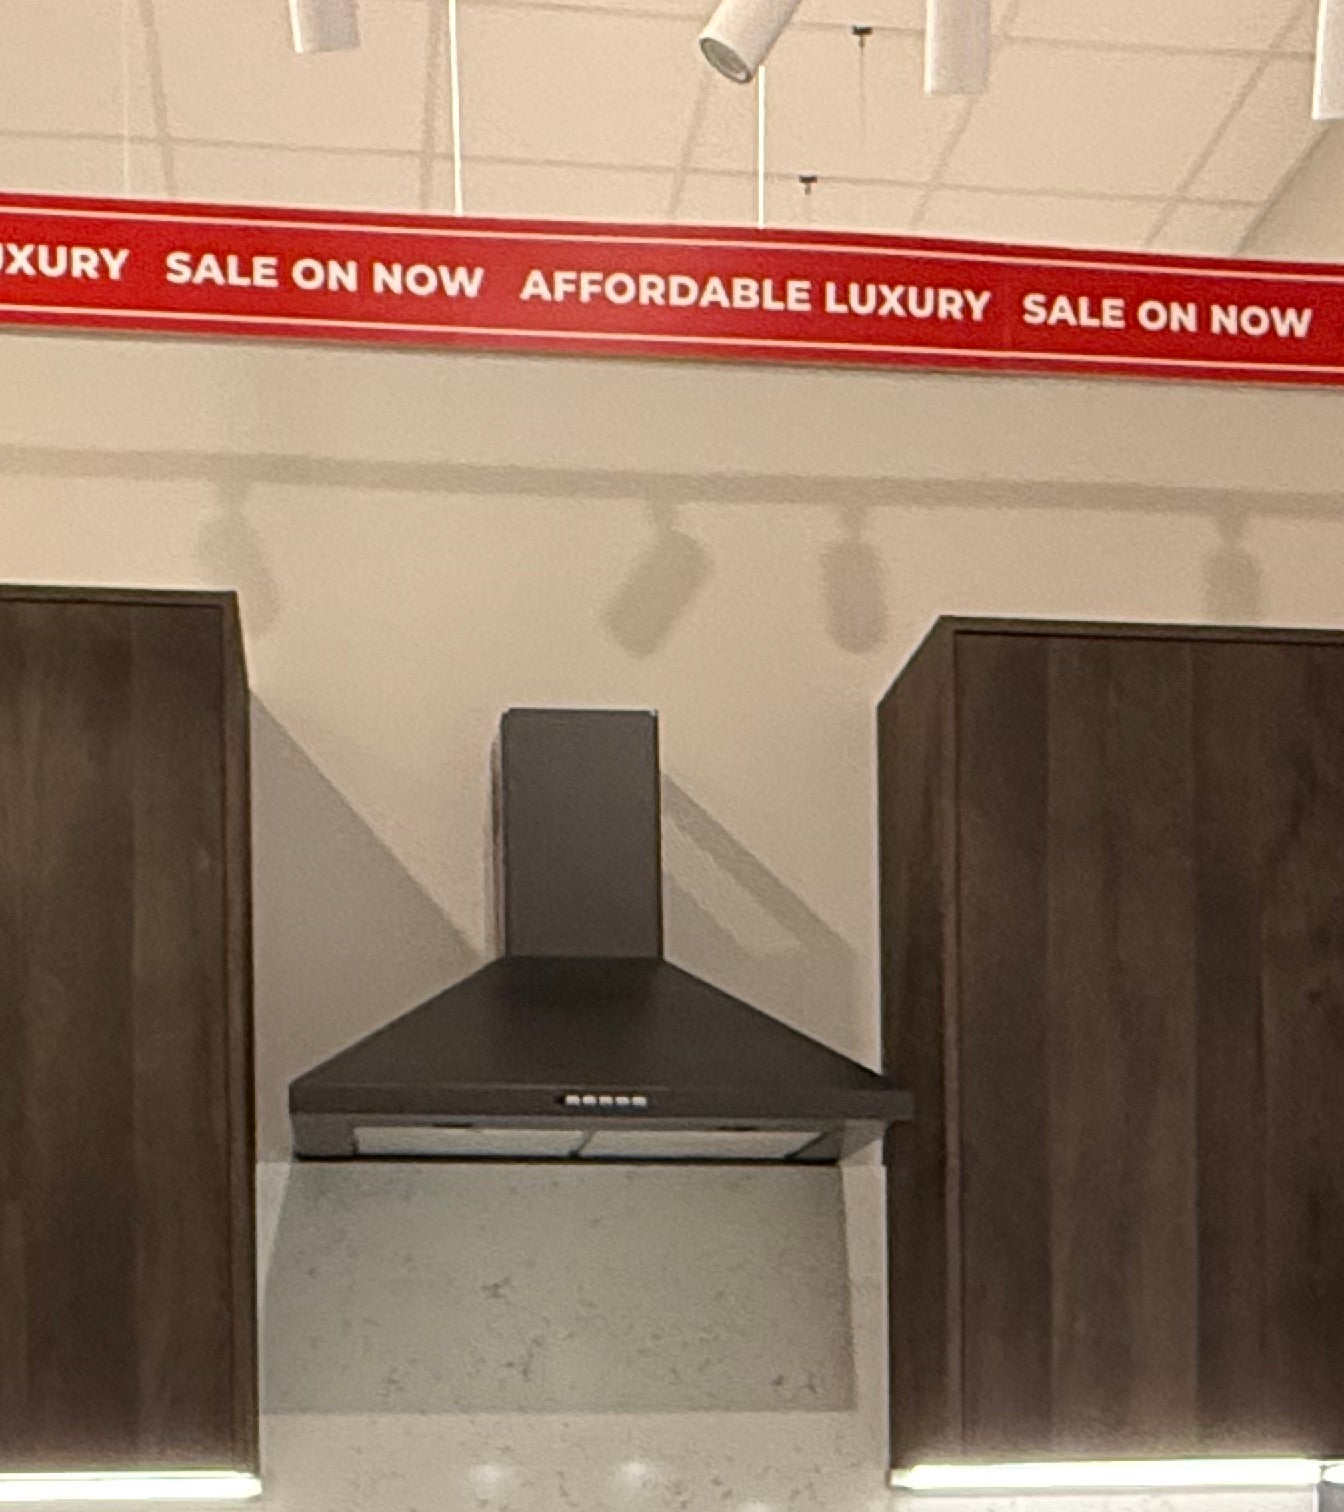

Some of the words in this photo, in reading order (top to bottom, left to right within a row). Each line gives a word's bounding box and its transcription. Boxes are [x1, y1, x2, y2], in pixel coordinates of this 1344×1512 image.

[166, 251, 279, 288] SALE
[292, 258, 358, 292] ON
[373, 262, 484, 299] NOW
[519, 269, 812, 312] AFFORDABLE
[825, 281, 991, 320] LUXURY
[1023, 293, 1125, 328] SALE
[1138, 300, 1196, 332] ON
[1210, 304, 1312, 338] NOW
